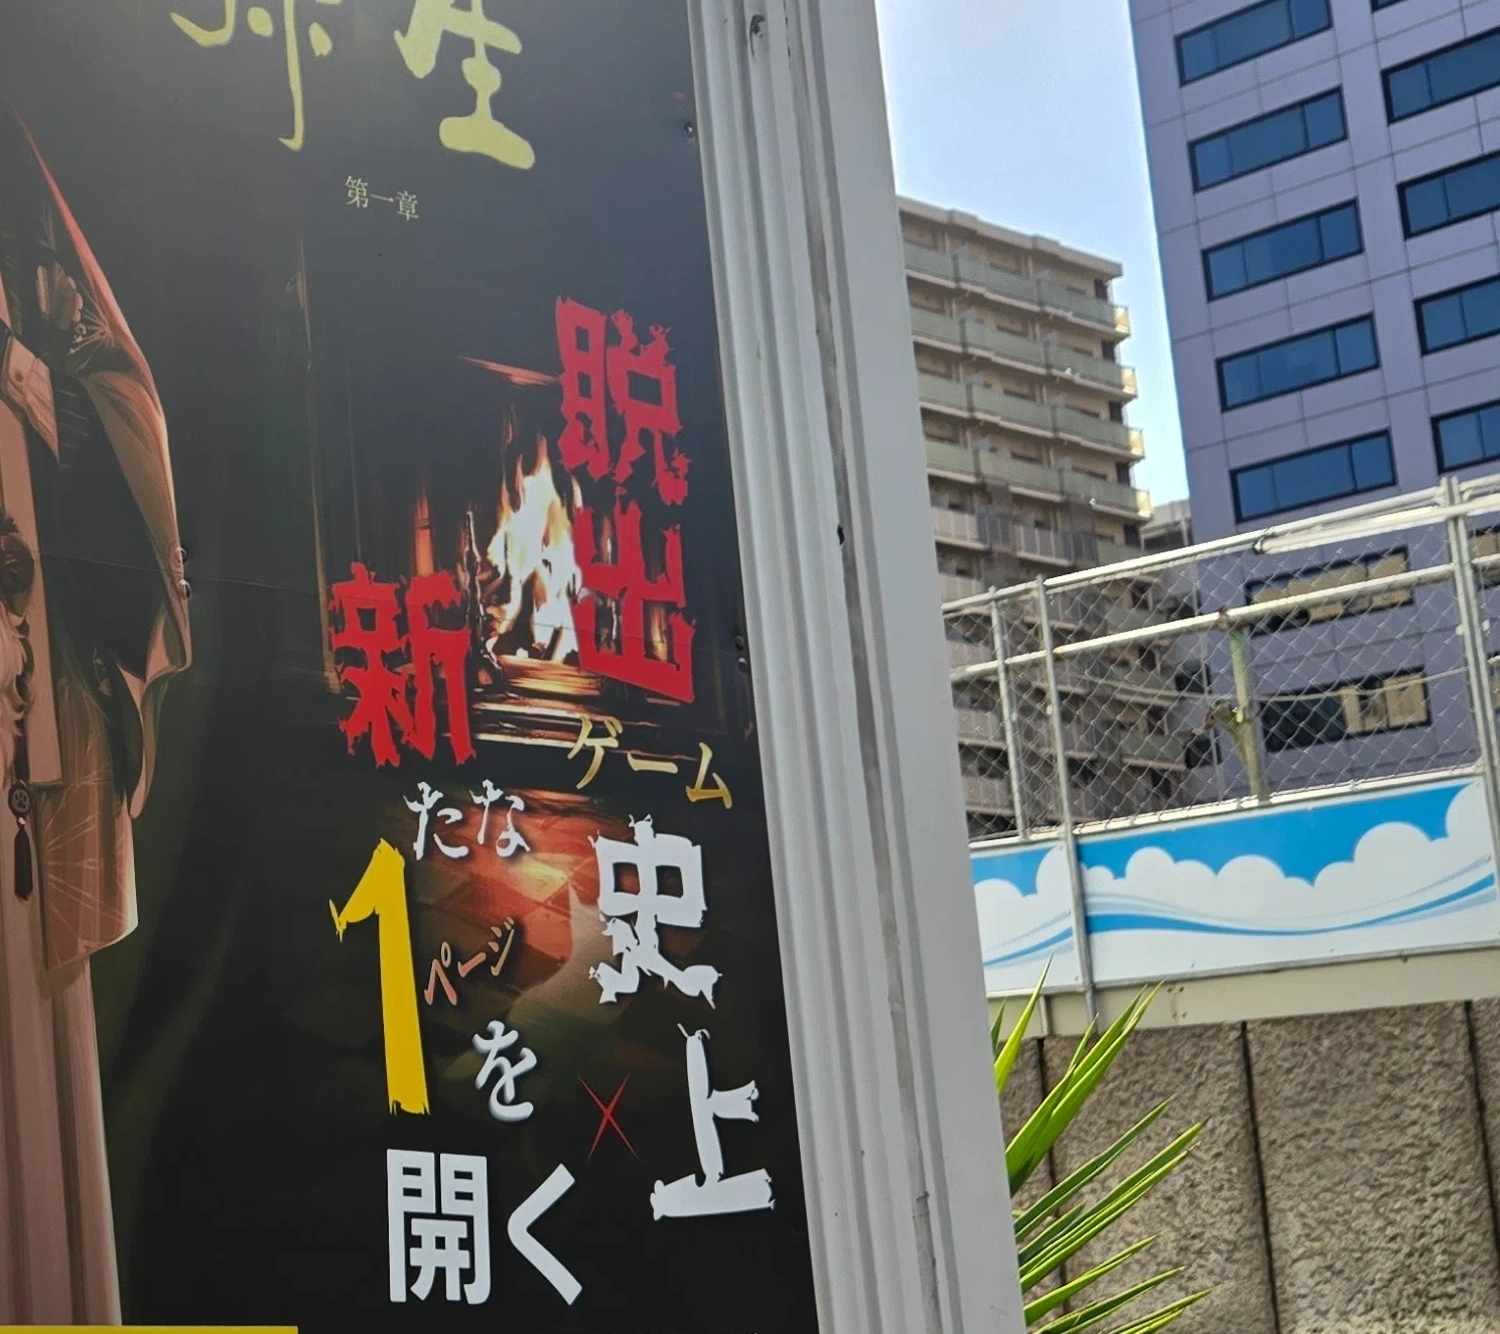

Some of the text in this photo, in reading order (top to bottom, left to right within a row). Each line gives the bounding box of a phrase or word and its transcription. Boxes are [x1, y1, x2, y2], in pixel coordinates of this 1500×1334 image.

[344, 175, 419, 222] 第一章
[567, 715, 732, 809] ゲーム
